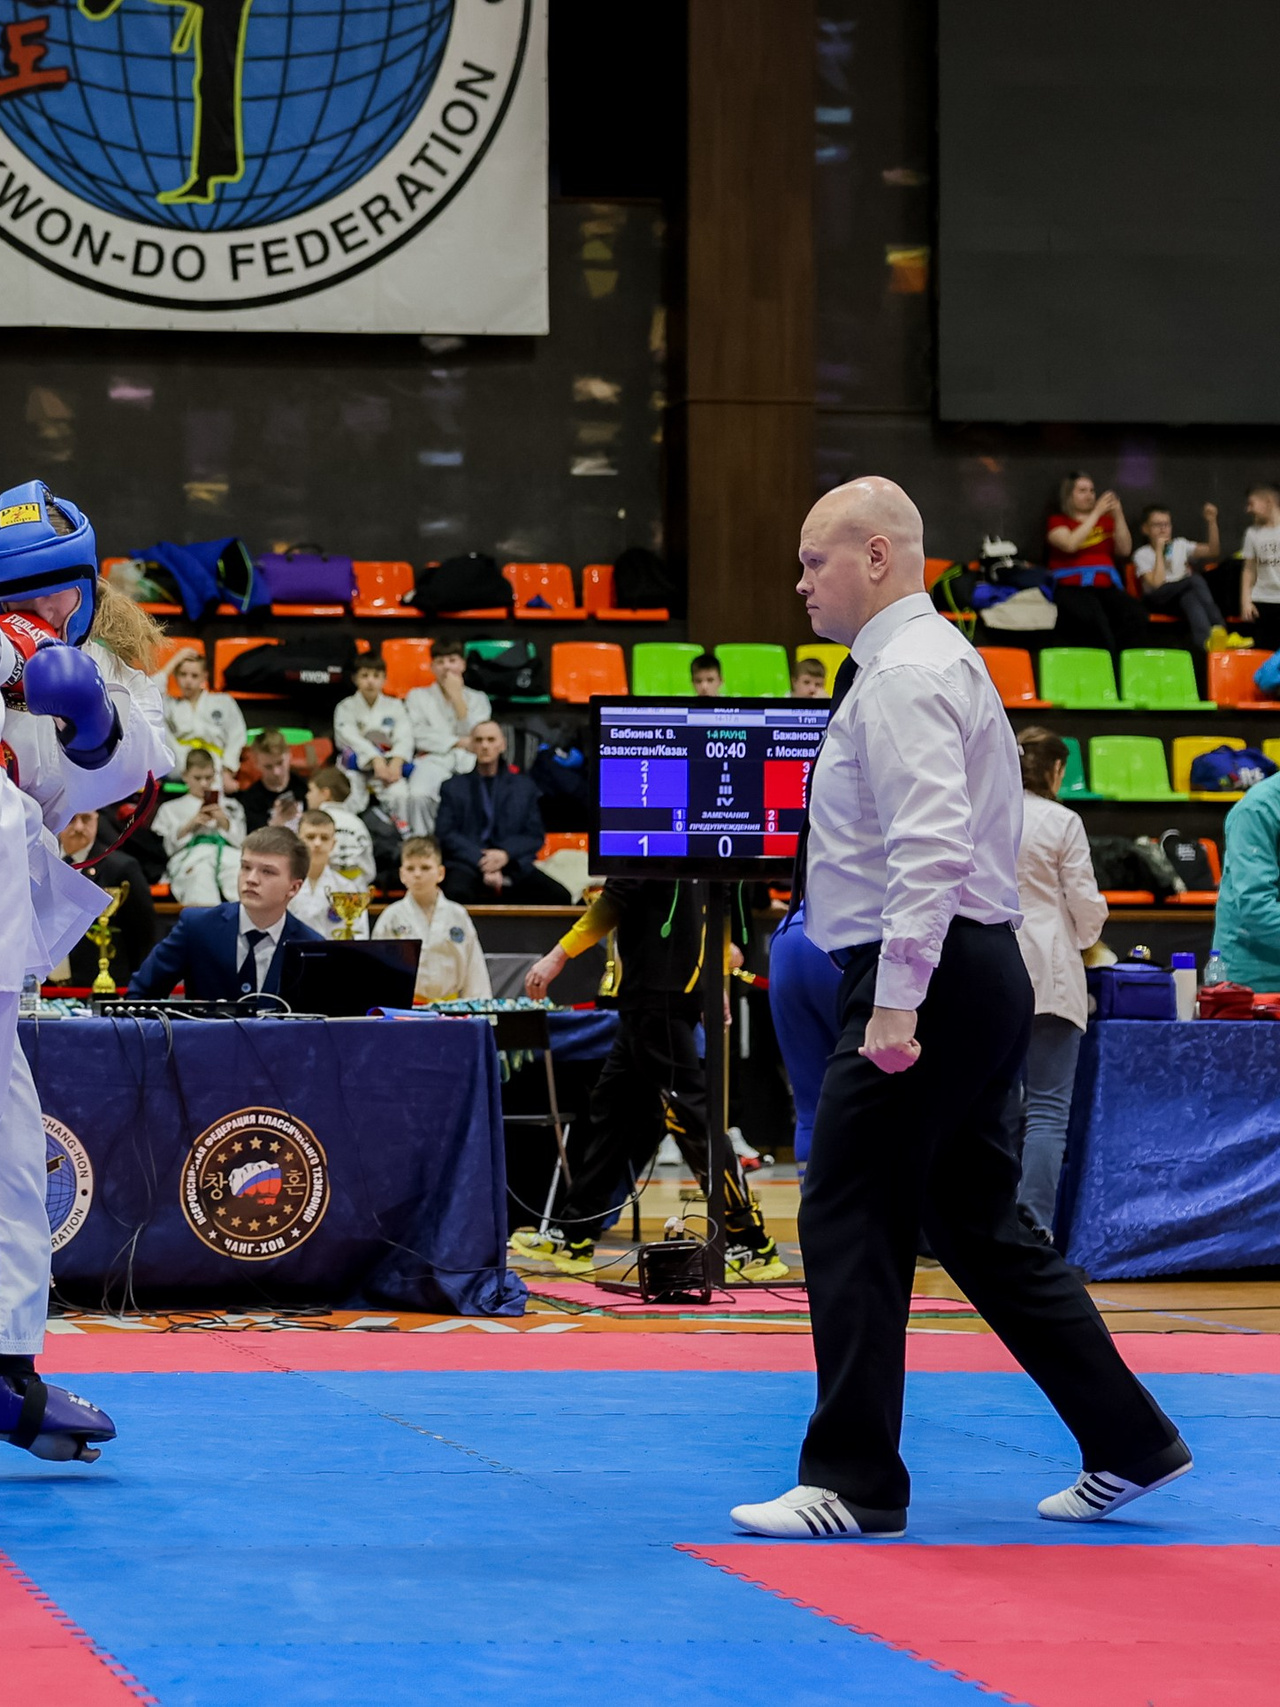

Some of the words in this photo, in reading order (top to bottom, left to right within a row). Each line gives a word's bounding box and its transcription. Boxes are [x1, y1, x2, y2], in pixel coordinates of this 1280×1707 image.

[228, 61, 496, 281] FEDERATION
[2, 613, 51, 648] EVERLAST
[610, 728, 654, 739] Бабкина
[654, 729, 665, 739] К.
[666, 729, 676, 739] В.
[720, 730, 747, 740] РАУНД
[773, 730, 819, 741] Бажанова
[705, 742, 746, 759] 00:40
[640, 760, 649, 771] 2
[802, 762, 810, 773] 3
[641, 773, 648, 783] 1
[641, 784, 649, 795] 7
[641, 796, 648, 807] 1
[716, 797, 734, 807] IV
[675, 810, 682, 819] 1
[701, 811, 750, 820] ЗАМЕЧАНИЯ
[767, 810, 775, 820] 2
[675, 821, 683, 832] 0
[689, 822, 761, 832] ПРЕДУПРЕЖДЕНИЯ
[767, 822, 775, 832] 0
[638, 835, 649, 857] 1
[718, 835, 733, 858] 0
[204, 1114, 256, 1147] ФЕДЕРАЦИЯ
[302, 1165, 324, 1223] ТХЭКВОНДО
[203, 1171, 229, 1200] 창
[283, 1169, 307, 1196] 혼
[51, 1207, 84, 1248] RATION
[223, 1236, 286, 1255] ЧАНГ-ХОН
